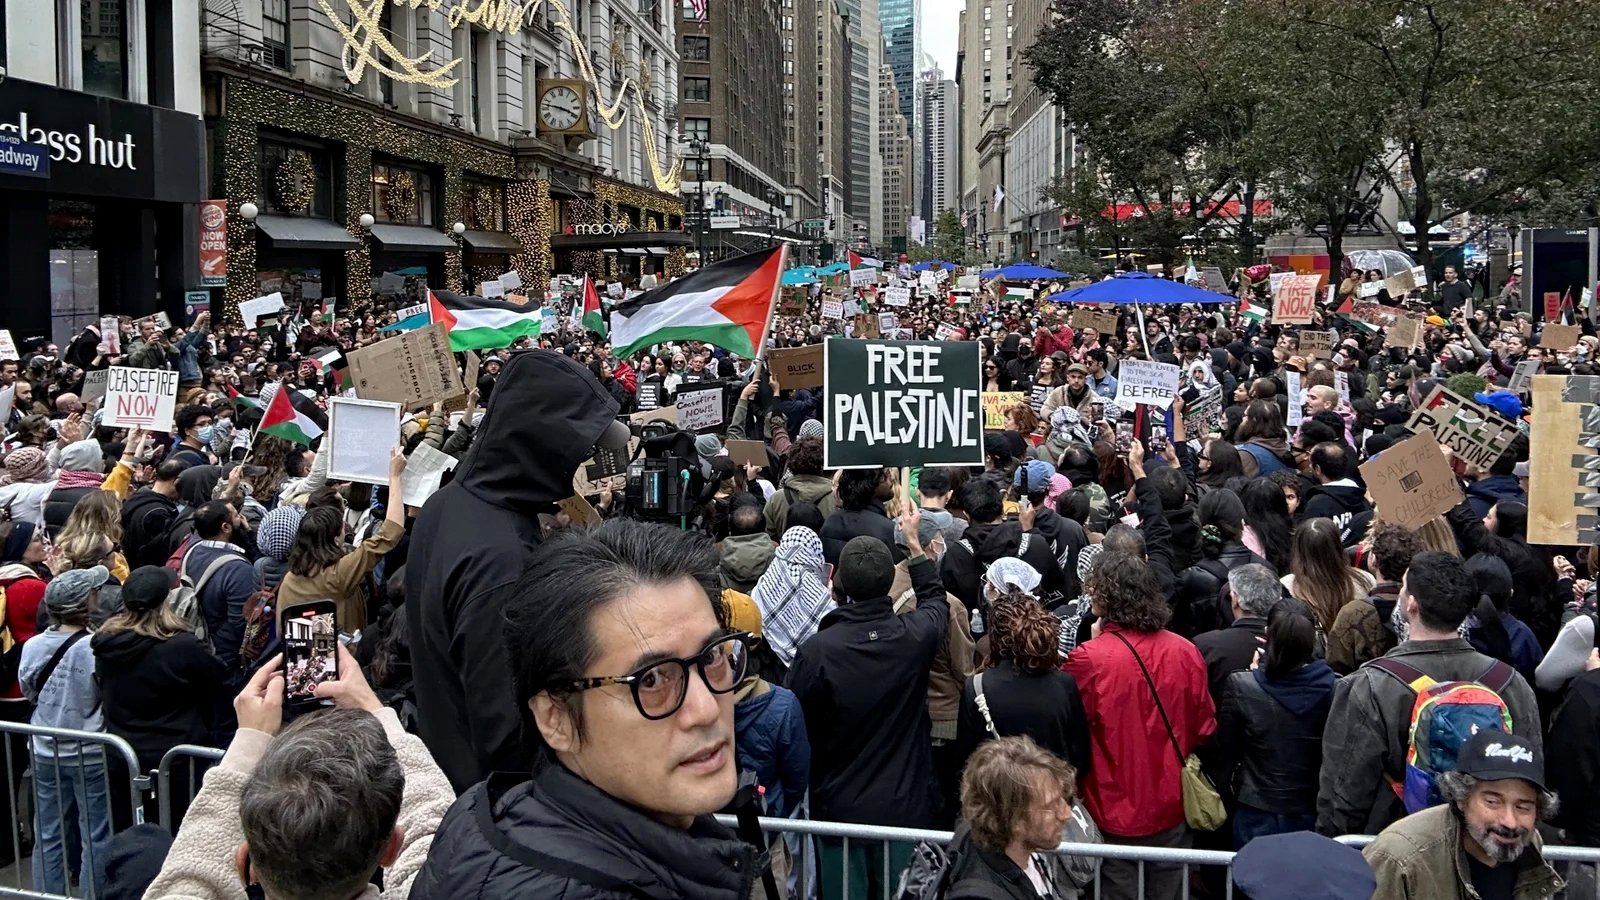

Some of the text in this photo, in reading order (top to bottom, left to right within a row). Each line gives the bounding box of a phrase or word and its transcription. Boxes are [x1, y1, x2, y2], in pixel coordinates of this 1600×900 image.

[88, 123, 137, 170] hut
[201, 241, 225, 250] OPEN
[203, 231, 224, 240] NOW
[1279, 286, 1311, 297] FIRE
[1304, 332, 1330, 341] END THE
[401, 337, 422, 399] BUTCHERBOX
[787, 363, 815, 372] BLICK
[865, 344, 944, 386] FREE
[108, 369, 177, 396] CEASEFIRE
[1121, 375, 1152, 386] PALESTINE
[1122, 384, 1173, 398] BE FREE
[117, 395, 160, 416] NOW
[676, 395, 717, 410] Ceasefire
[982, 395, 999, 405] IVA
[834, 387, 977, 449] PALESTINE
[1426, 389, 1518, 453] FREE
[1411, 412, 1499, 469] PALESTINE
[1411, 443, 1435, 464] THE
[1394, 477, 1456, 523] CHILDREN!
